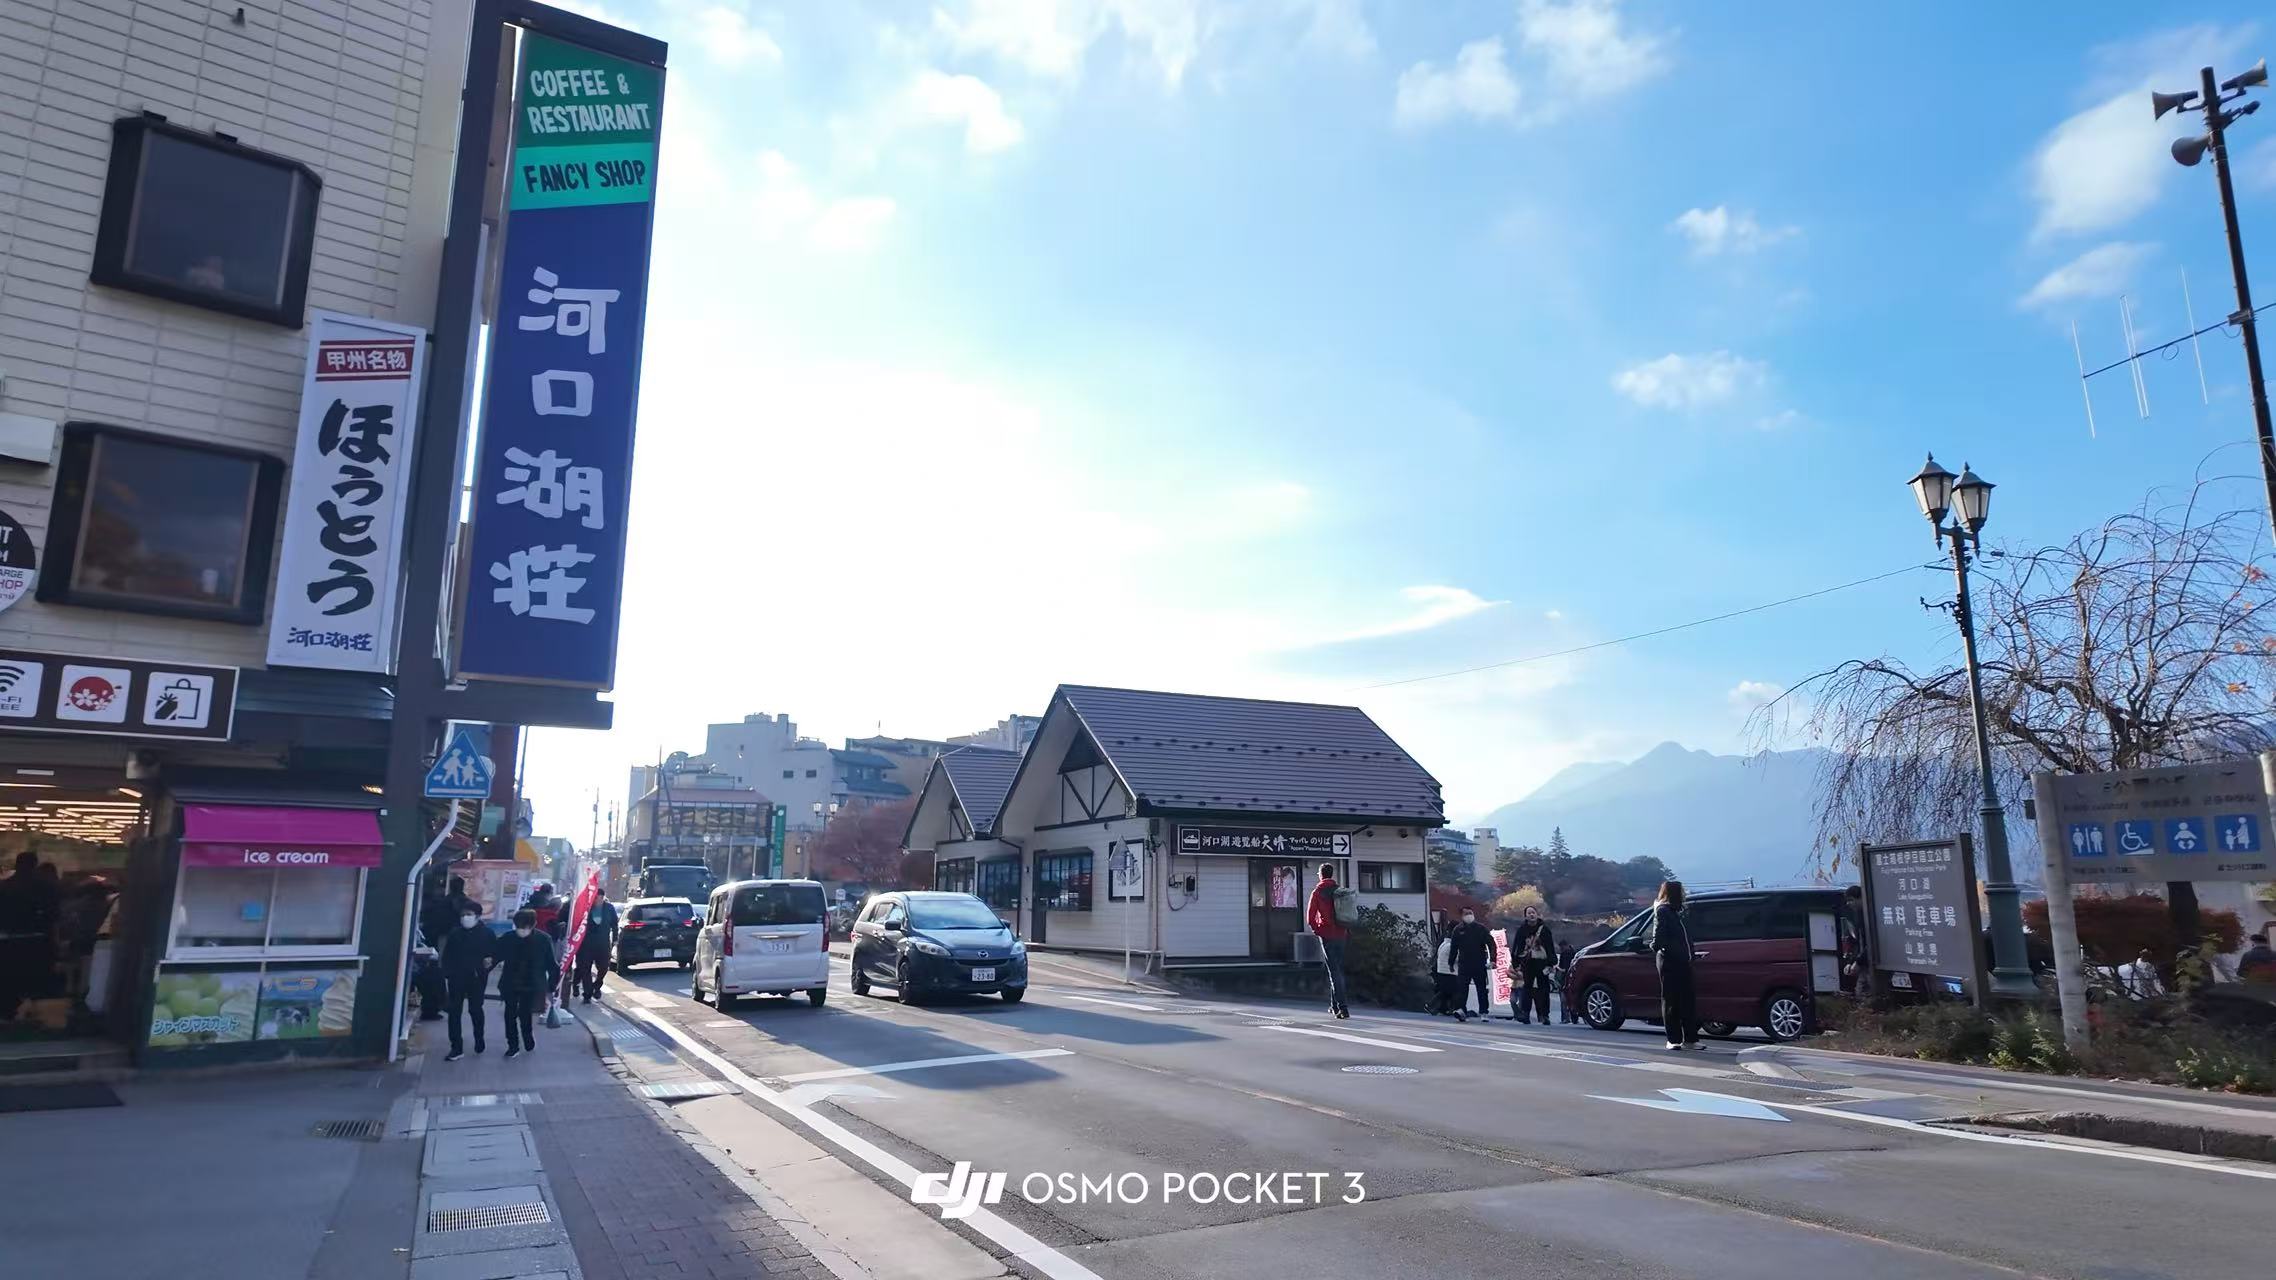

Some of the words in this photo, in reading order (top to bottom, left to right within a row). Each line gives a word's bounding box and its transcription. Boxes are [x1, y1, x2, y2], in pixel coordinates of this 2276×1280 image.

[530, 69, 610, 97] COFFEE
[616, 73, 630, 95] &
[527, 103, 651, 134] RESTAURANT
[523, 162, 590, 193] FANCY
[594, 160, 646, 188] SHOP
[326, 349, 408, 371] 甲州名物
[489, 266, 621, 625] 河口湖荘
[307, 398, 394, 616] ほうとう
[286, 627, 373, 651] 河口湖荘
[244, 849, 271, 864] ice
[276, 852, 329, 864] cream
[1882, 906, 1906, 925] 無料
[1915, 905, 1957, 927] 駐車場
